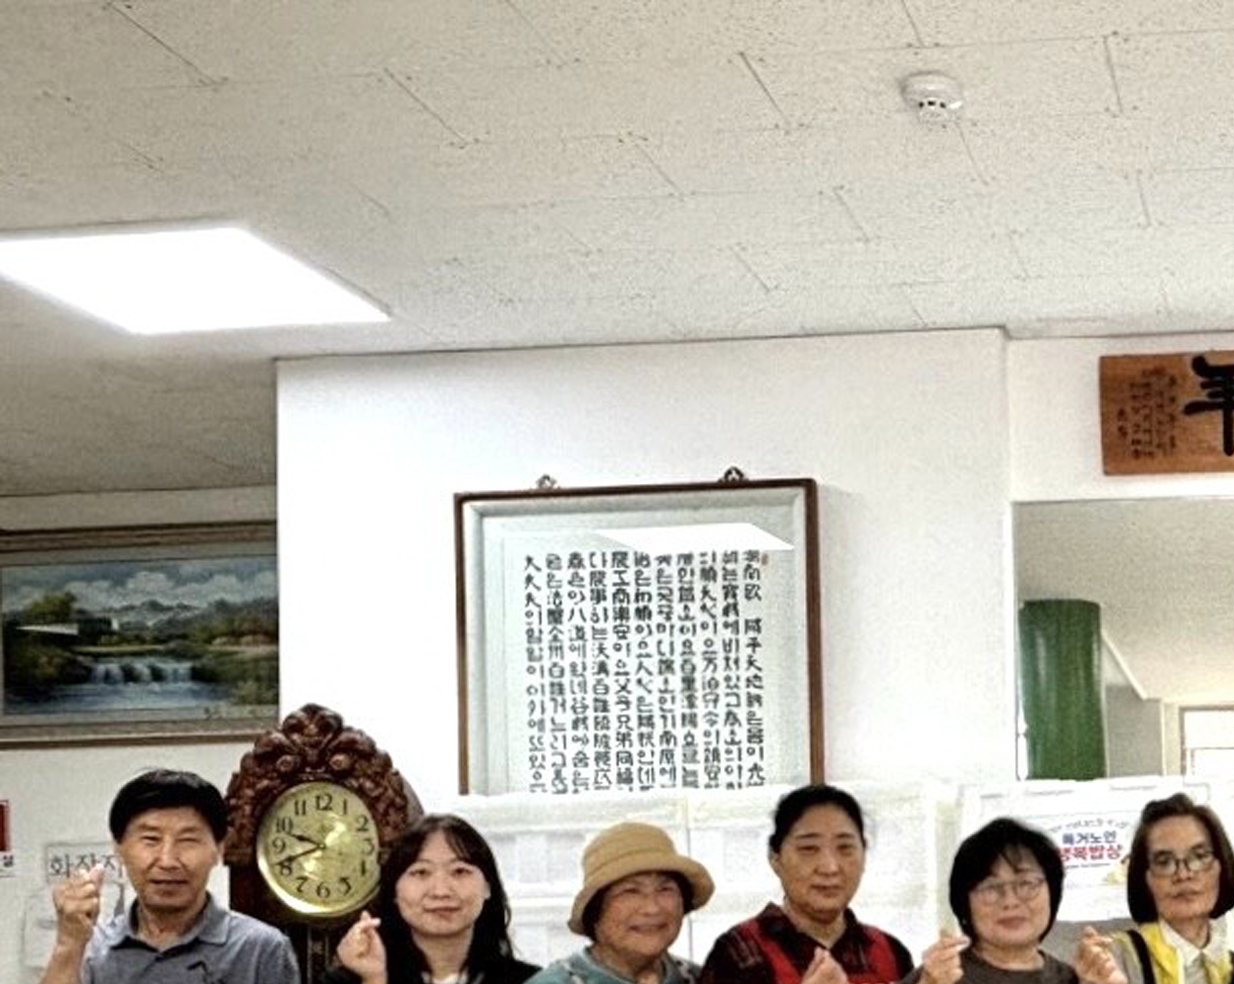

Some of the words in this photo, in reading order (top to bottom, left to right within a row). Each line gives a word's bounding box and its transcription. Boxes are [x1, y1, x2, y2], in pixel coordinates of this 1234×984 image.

[293, 799, 307, 816] 11
[315, 793, 333, 811] 12
[356, 814, 369, 832] 2
[271, 836, 286, 853] 9
[316, 881, 331, 898] 6
